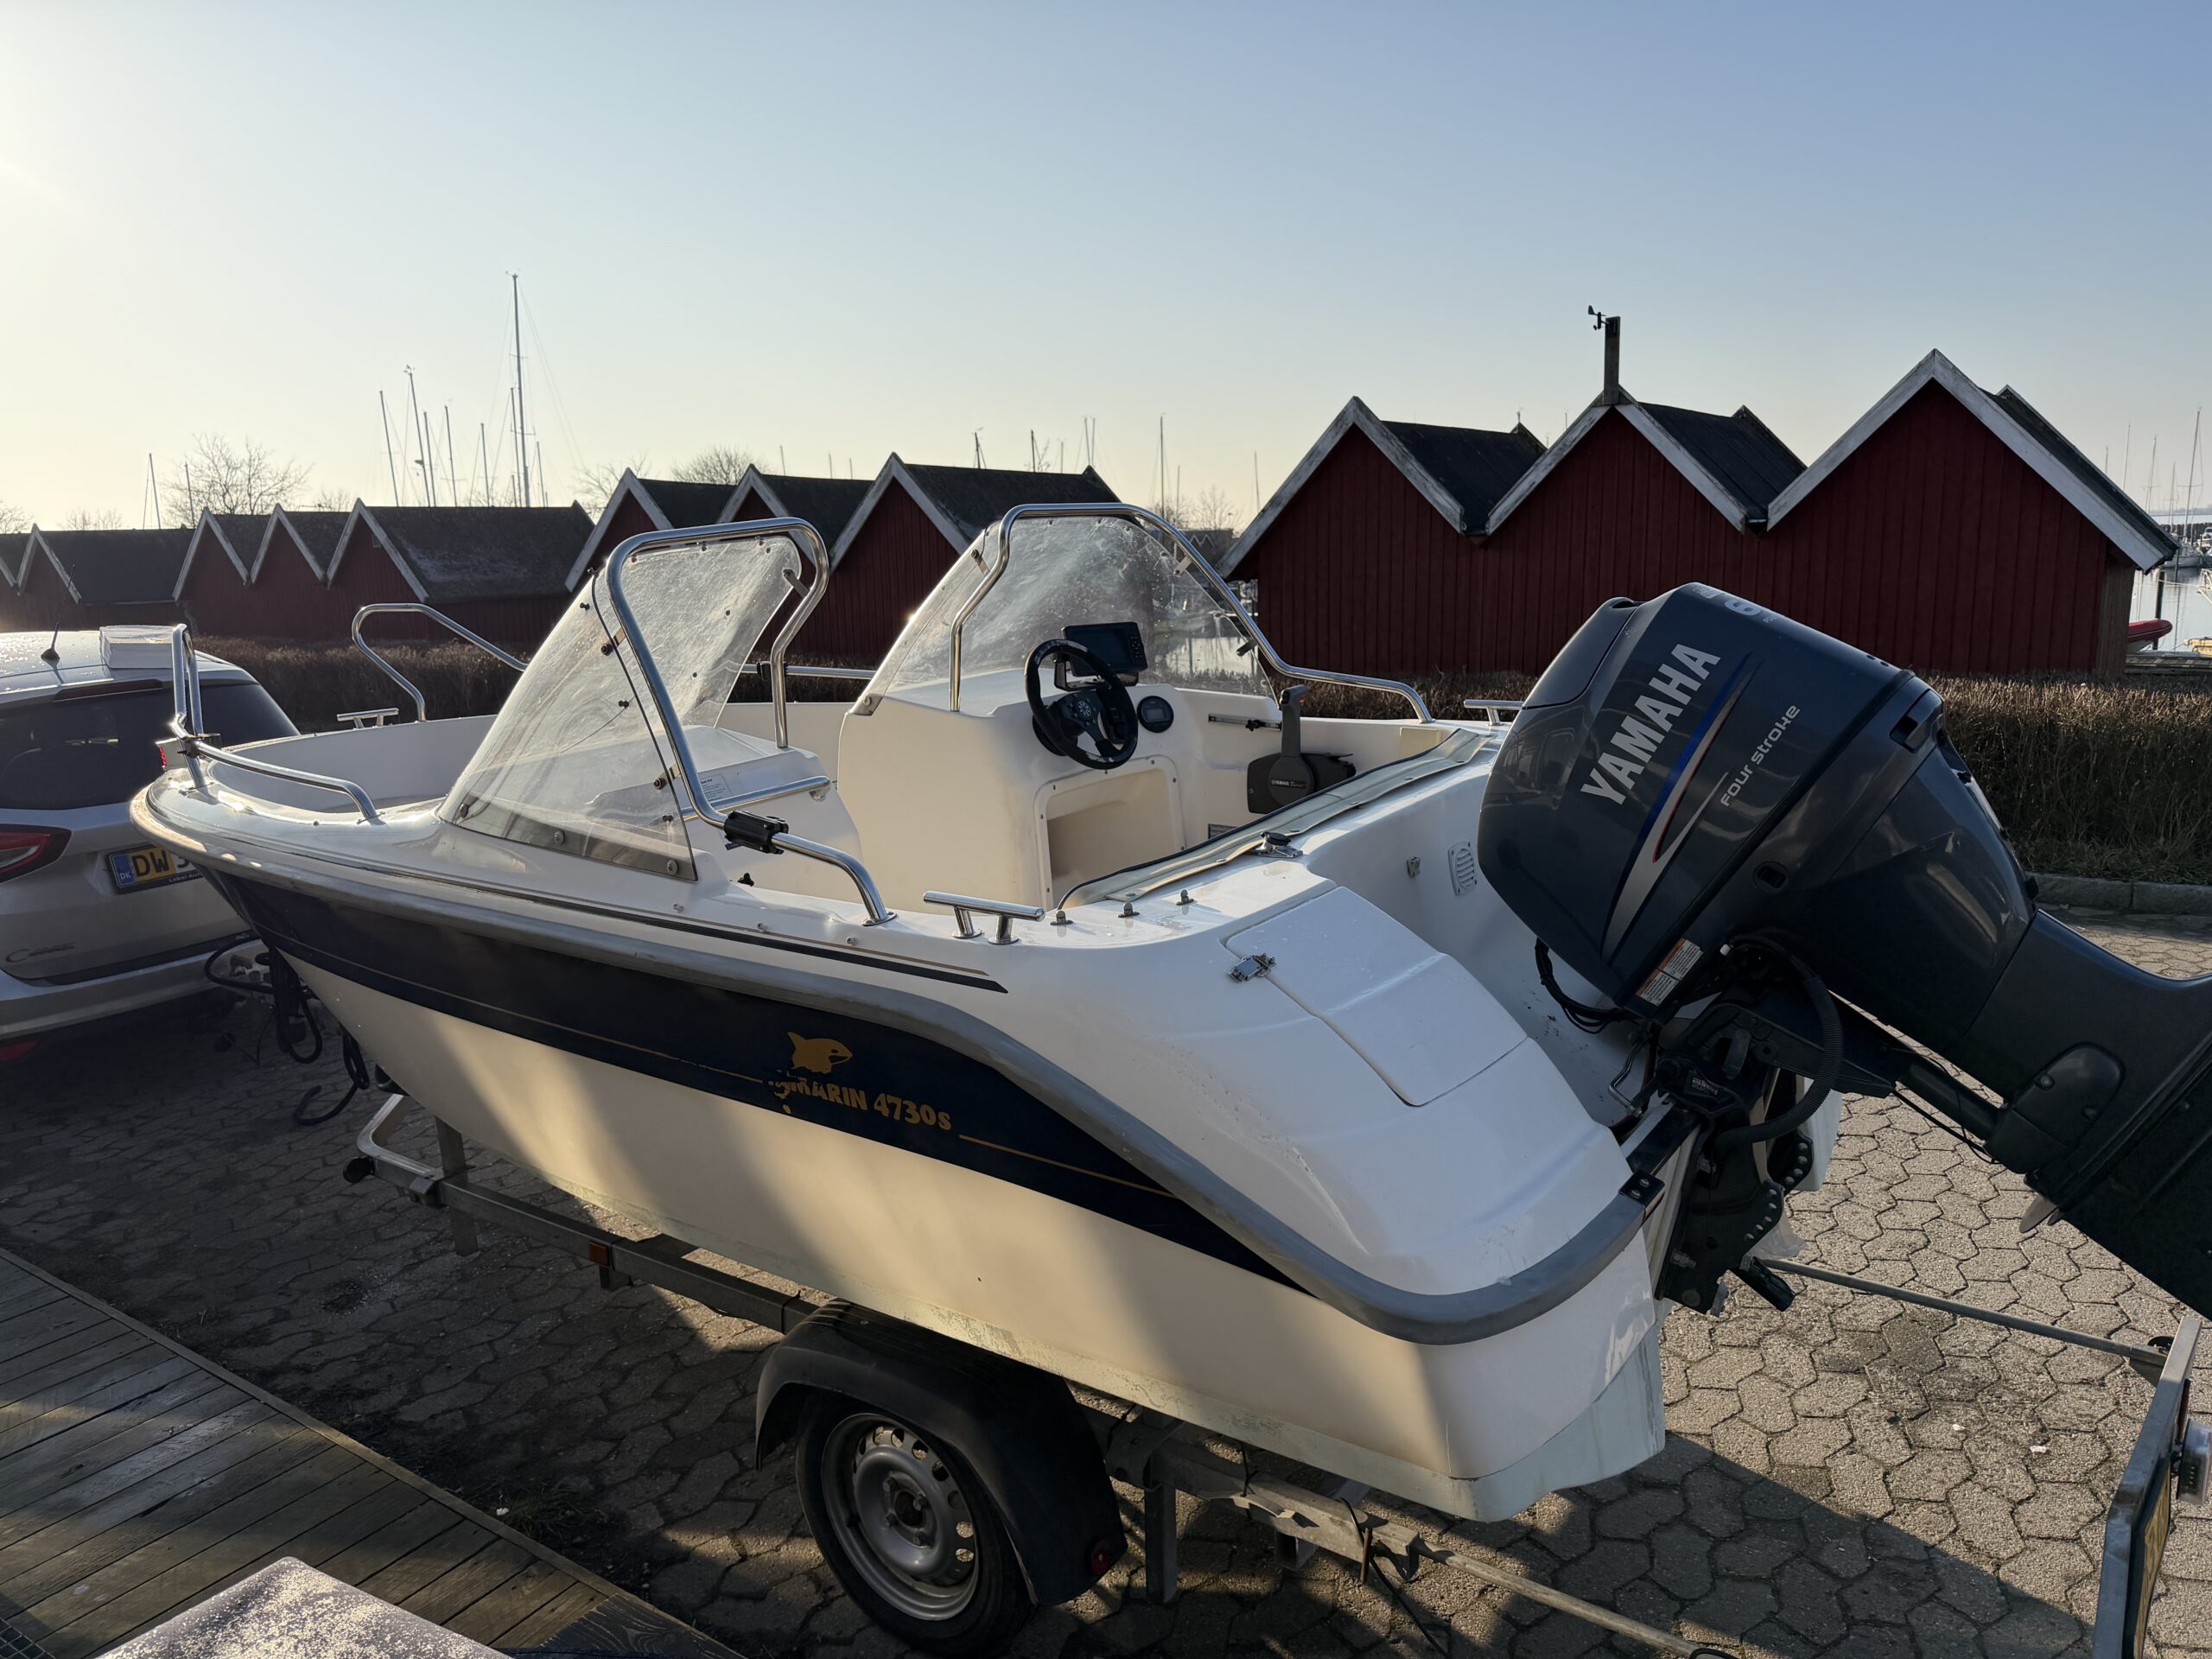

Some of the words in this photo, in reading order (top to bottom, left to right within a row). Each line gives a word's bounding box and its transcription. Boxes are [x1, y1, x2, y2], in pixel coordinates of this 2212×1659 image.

[1580, 643, 1721, 805] YAMAHA
[119, 871, 131, 880] DK
[131, 849, 169, 877] DW
